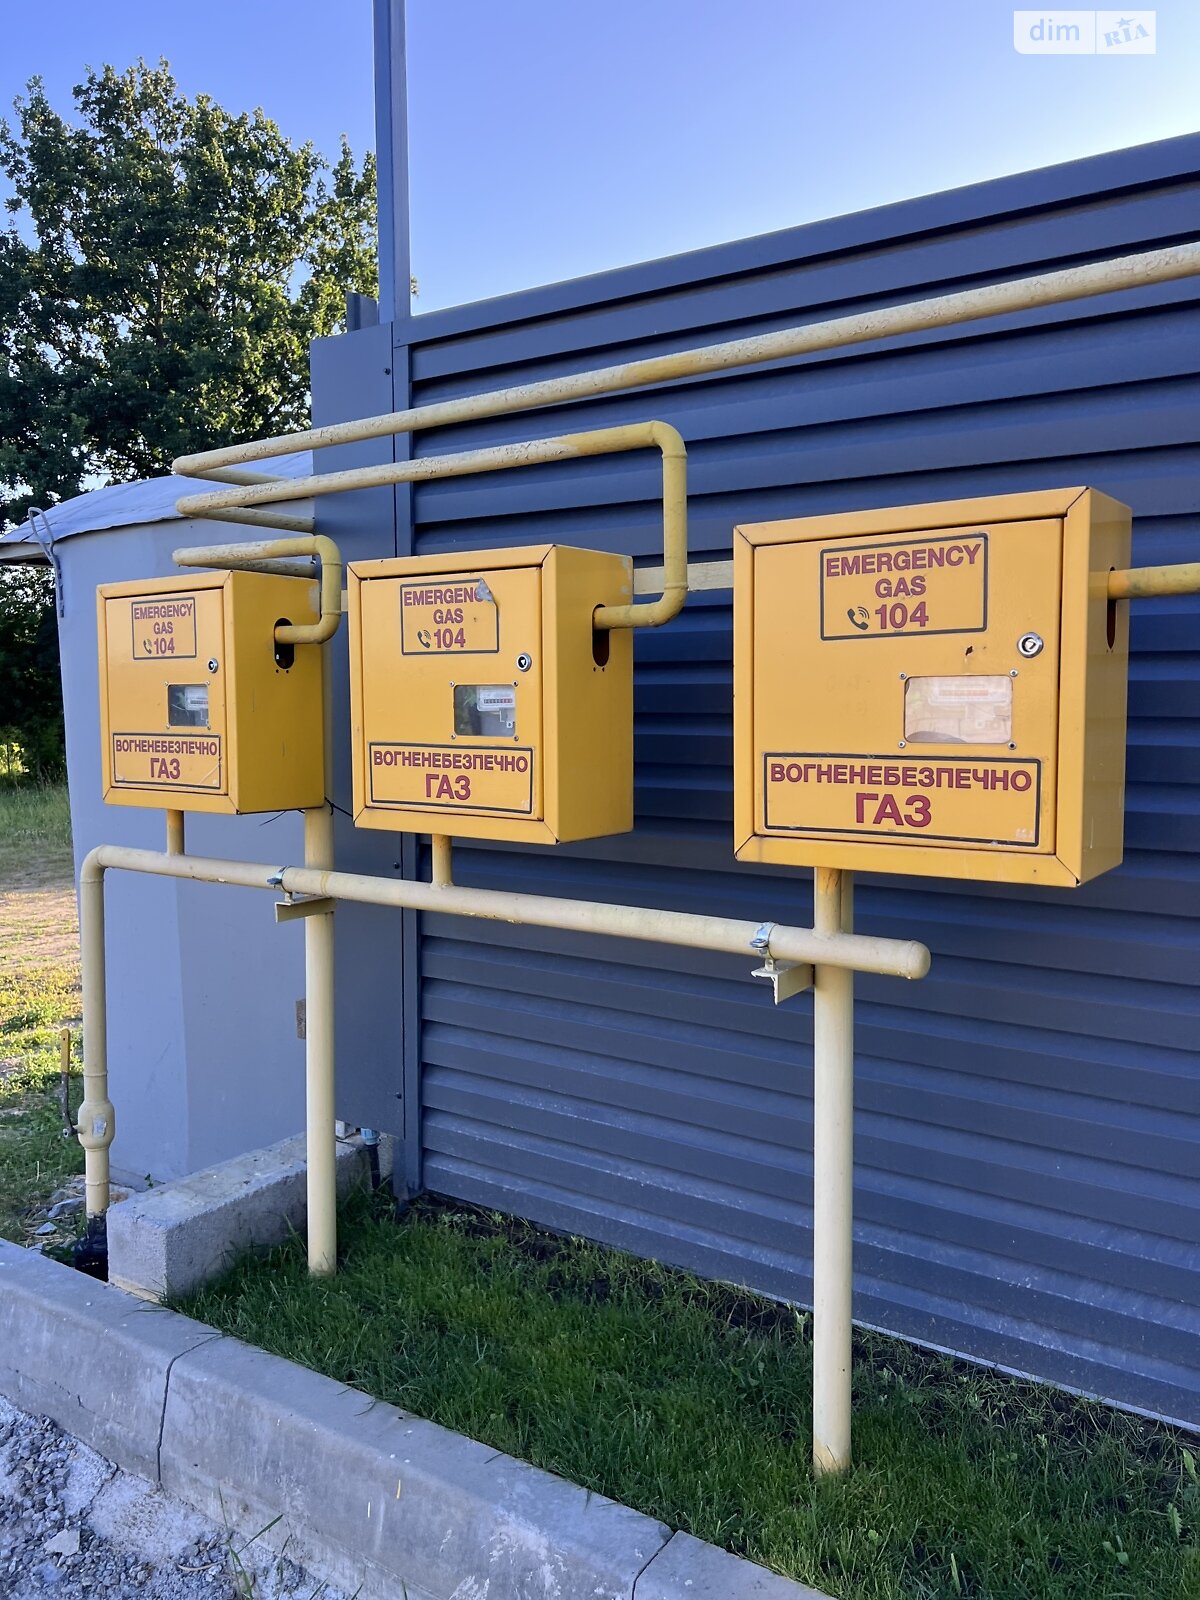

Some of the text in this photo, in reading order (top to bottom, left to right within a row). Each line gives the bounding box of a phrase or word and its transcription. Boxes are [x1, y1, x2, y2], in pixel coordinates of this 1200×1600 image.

[826, 543, 982, 577] EMERGENCY
[875, 575, 927, 599] GAS
[133, 603, 193, 620] EMERGENCY
[433, 608, 464, 625] GAS
[874, 601, 929, 630] 104
[153, 621, 174, 635] GAS
[433, 627, 466, 649] 104
[153, 637, 175, 655] 104
[115, 739, 218, 756] ВОГНЕНЕБЕЗПЕЧНО
[150, 757, 181, 780] ГАЗ
[373, 750, 529, 773] ВОГНЕНЕБЕЗПЕЧНО
[425, 773, 471, 800] ГАЗ
[770, 763, 1032, 792] ВОГНЕНЕБЕЗПЕЧНО
[855, 792, 932, 828] ГАЗ
